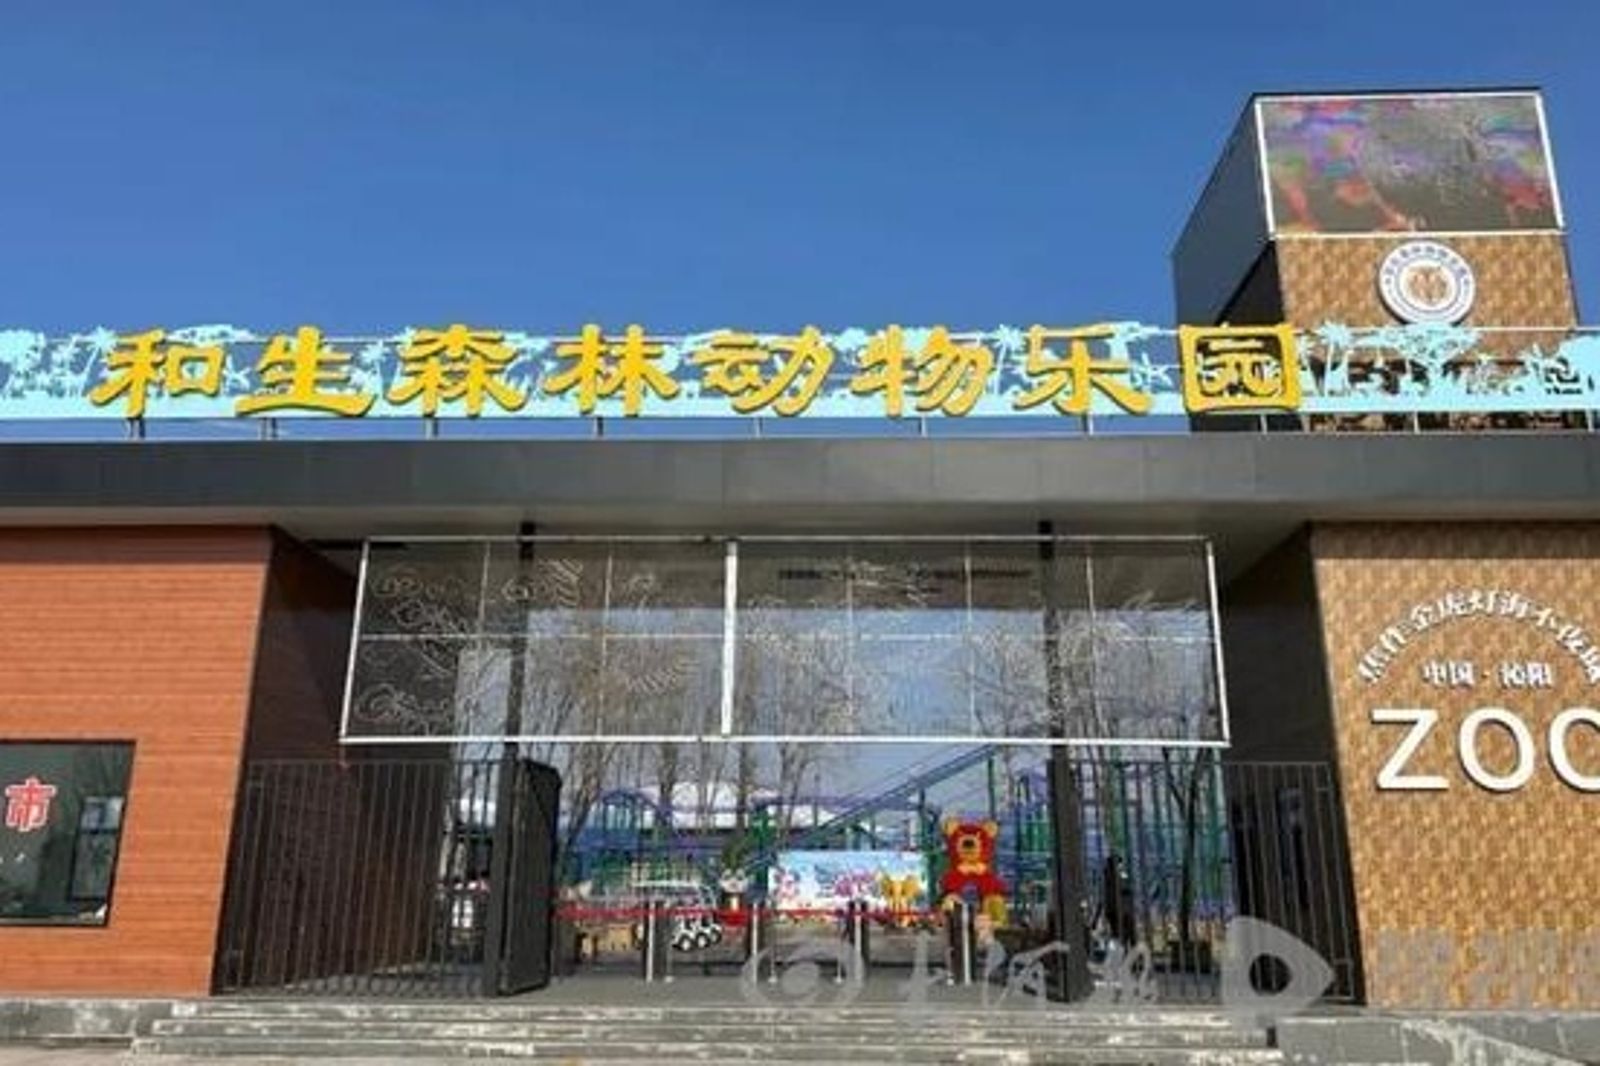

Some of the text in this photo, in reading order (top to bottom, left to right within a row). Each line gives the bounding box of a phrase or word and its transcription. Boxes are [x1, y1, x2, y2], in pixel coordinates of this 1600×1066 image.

[91, 324, 1303, 417] 和生森林动物乐园
